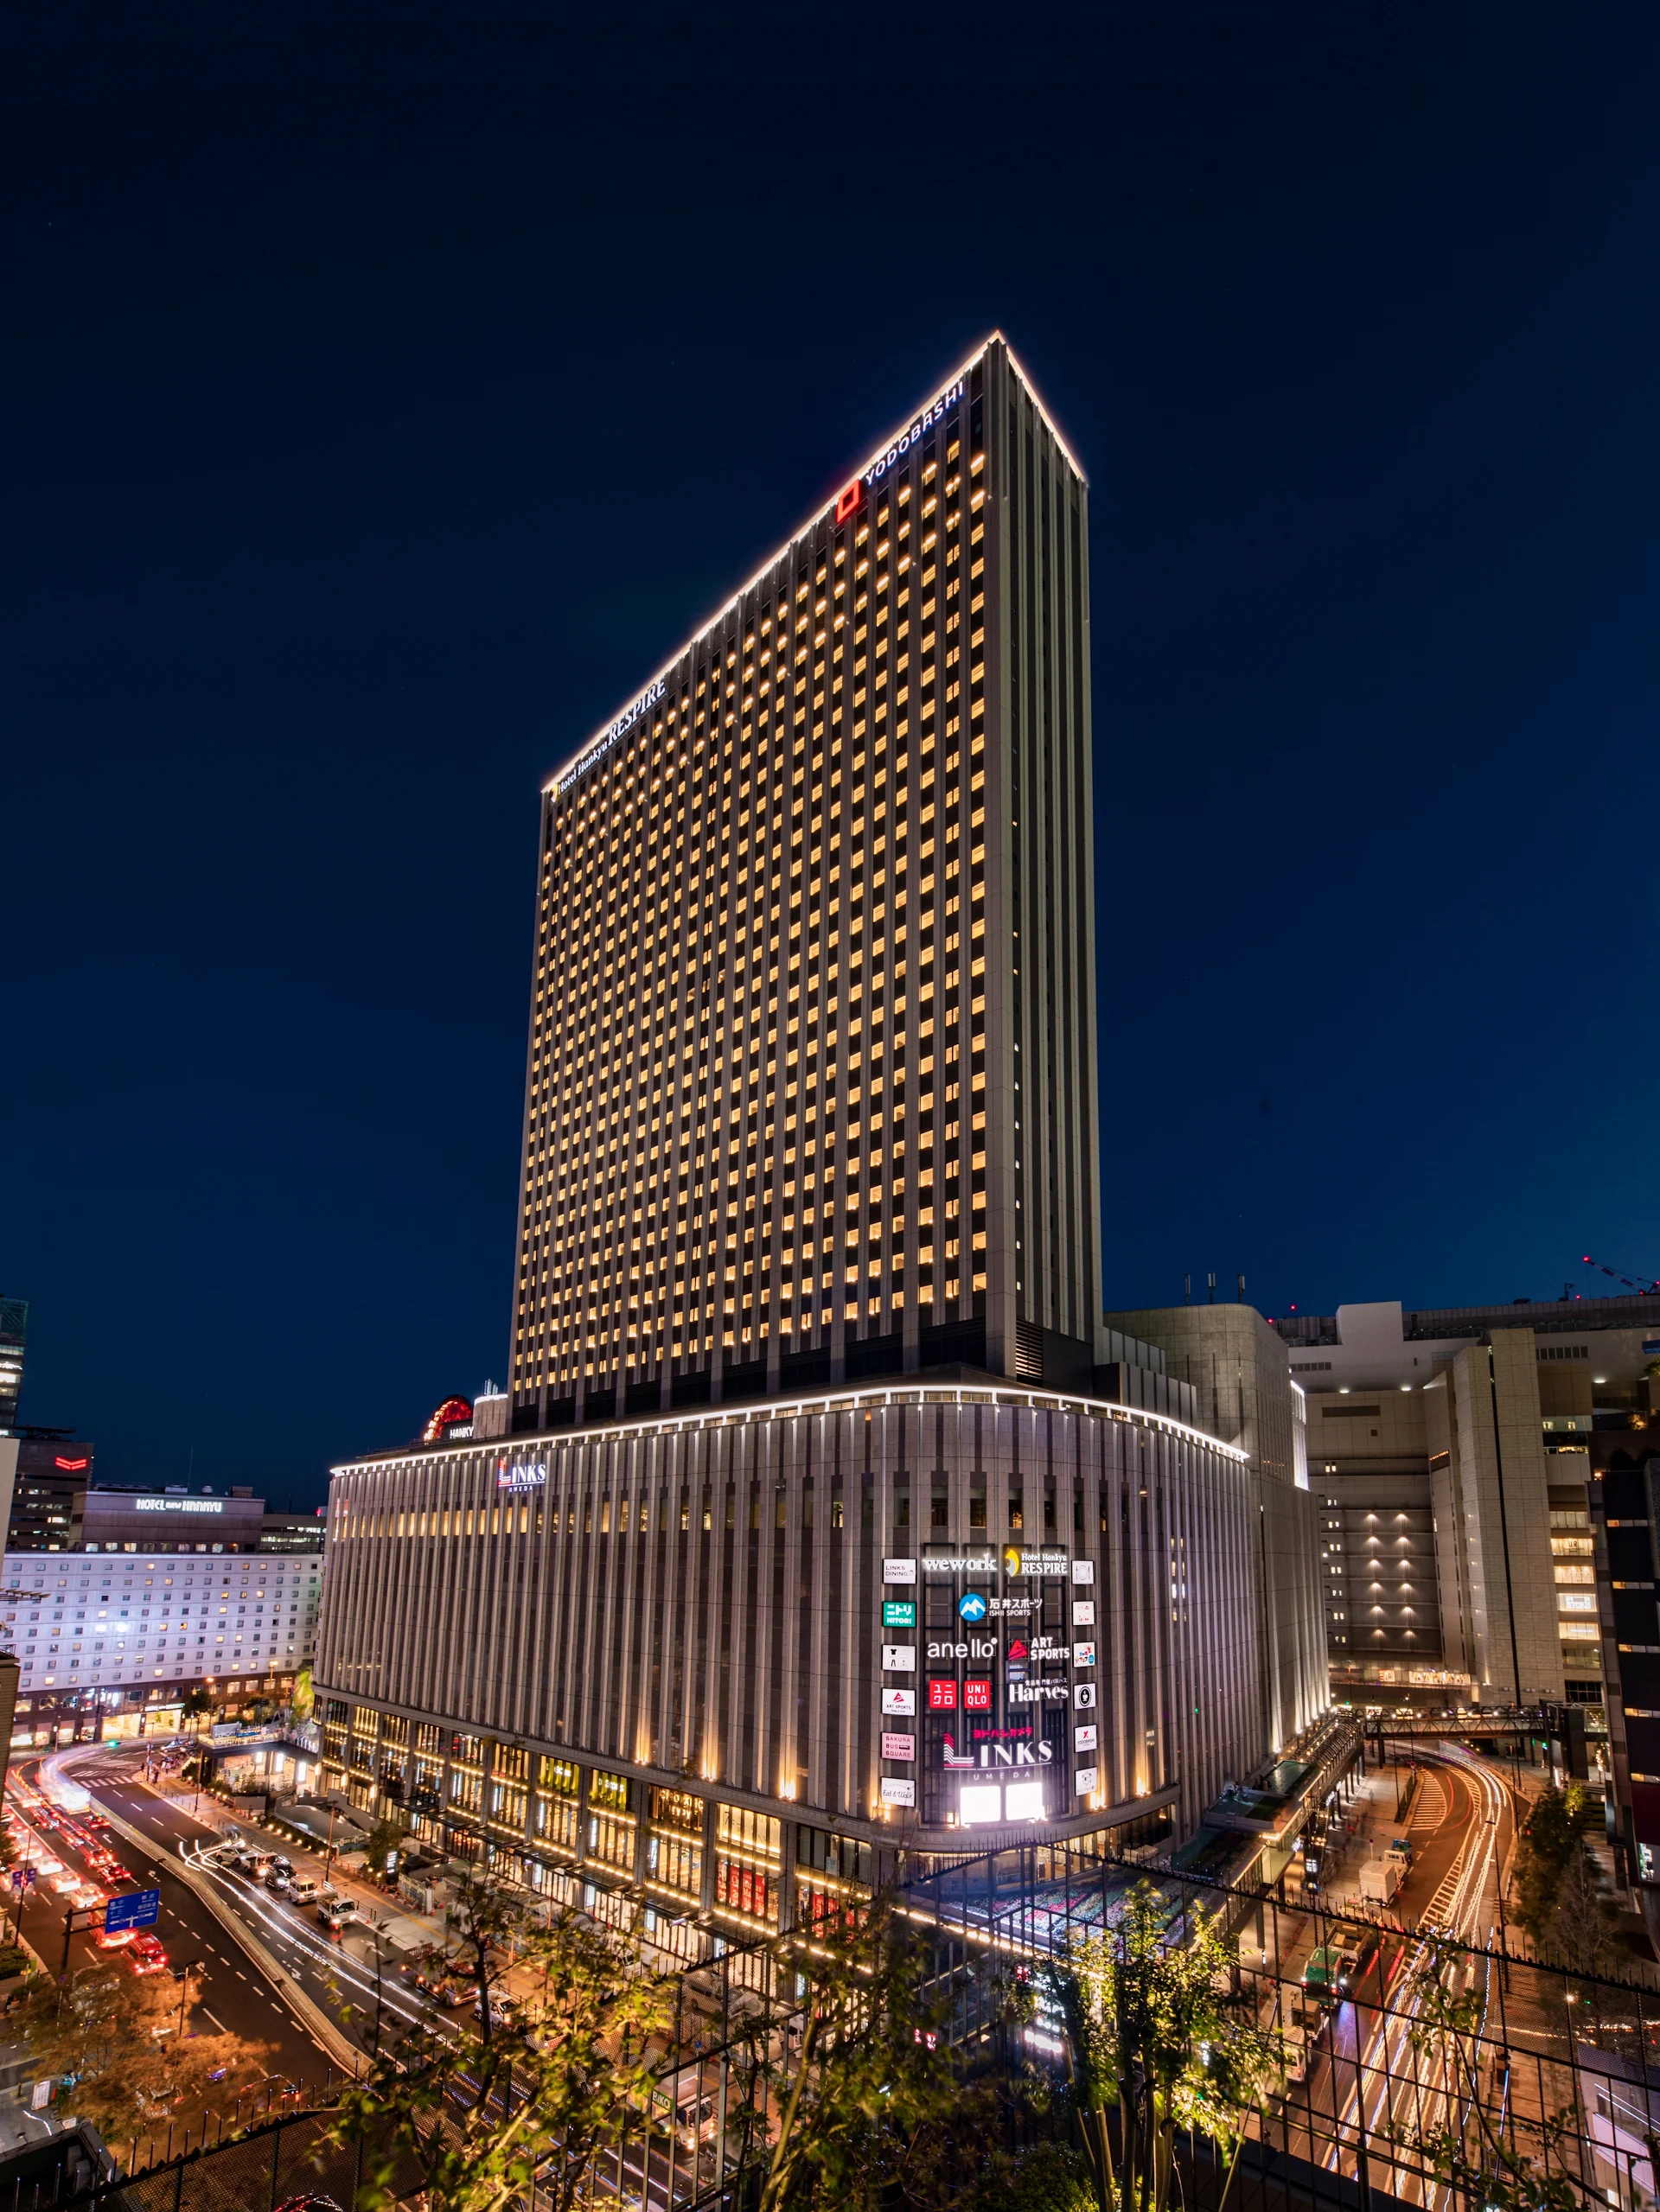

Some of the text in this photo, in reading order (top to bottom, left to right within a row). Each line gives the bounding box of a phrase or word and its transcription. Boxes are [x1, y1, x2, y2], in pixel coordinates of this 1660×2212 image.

[865, 381, 964, 487] YODOBASHI
[558, 678, 666, 794] Hotel Hankyu RESPIRE
[498, 1458, 546, 1485] LINKS
[136, 1499, 165, 1511] HOTEL
[922, 1552, 998, 1571] wework
[1042, 1553, 1068, 1563] Hankyu
[1021, 1562, 1068, 1574] RESPIRE
[887, 1604, 912, 1616] ニトリ
[927, 1638, 998, 1658] anello
[1031, 1636, 1053, 1648] ART
[1030, 1648, 1070, 1661] SPORTS
[933, 1684, 953, 1693] ユニ
[967, 1684, 986, 1694] UNI
[1009, 1684, 1069, 1703] Harves
[967, 1695, 987, 1706] QLO
[973, 1726, 1033, 1739] ヨドバシカメラ
[943, 1732, 1052, 1769] LINKS
[973, 1770, 1031, 1781] UMEDA
